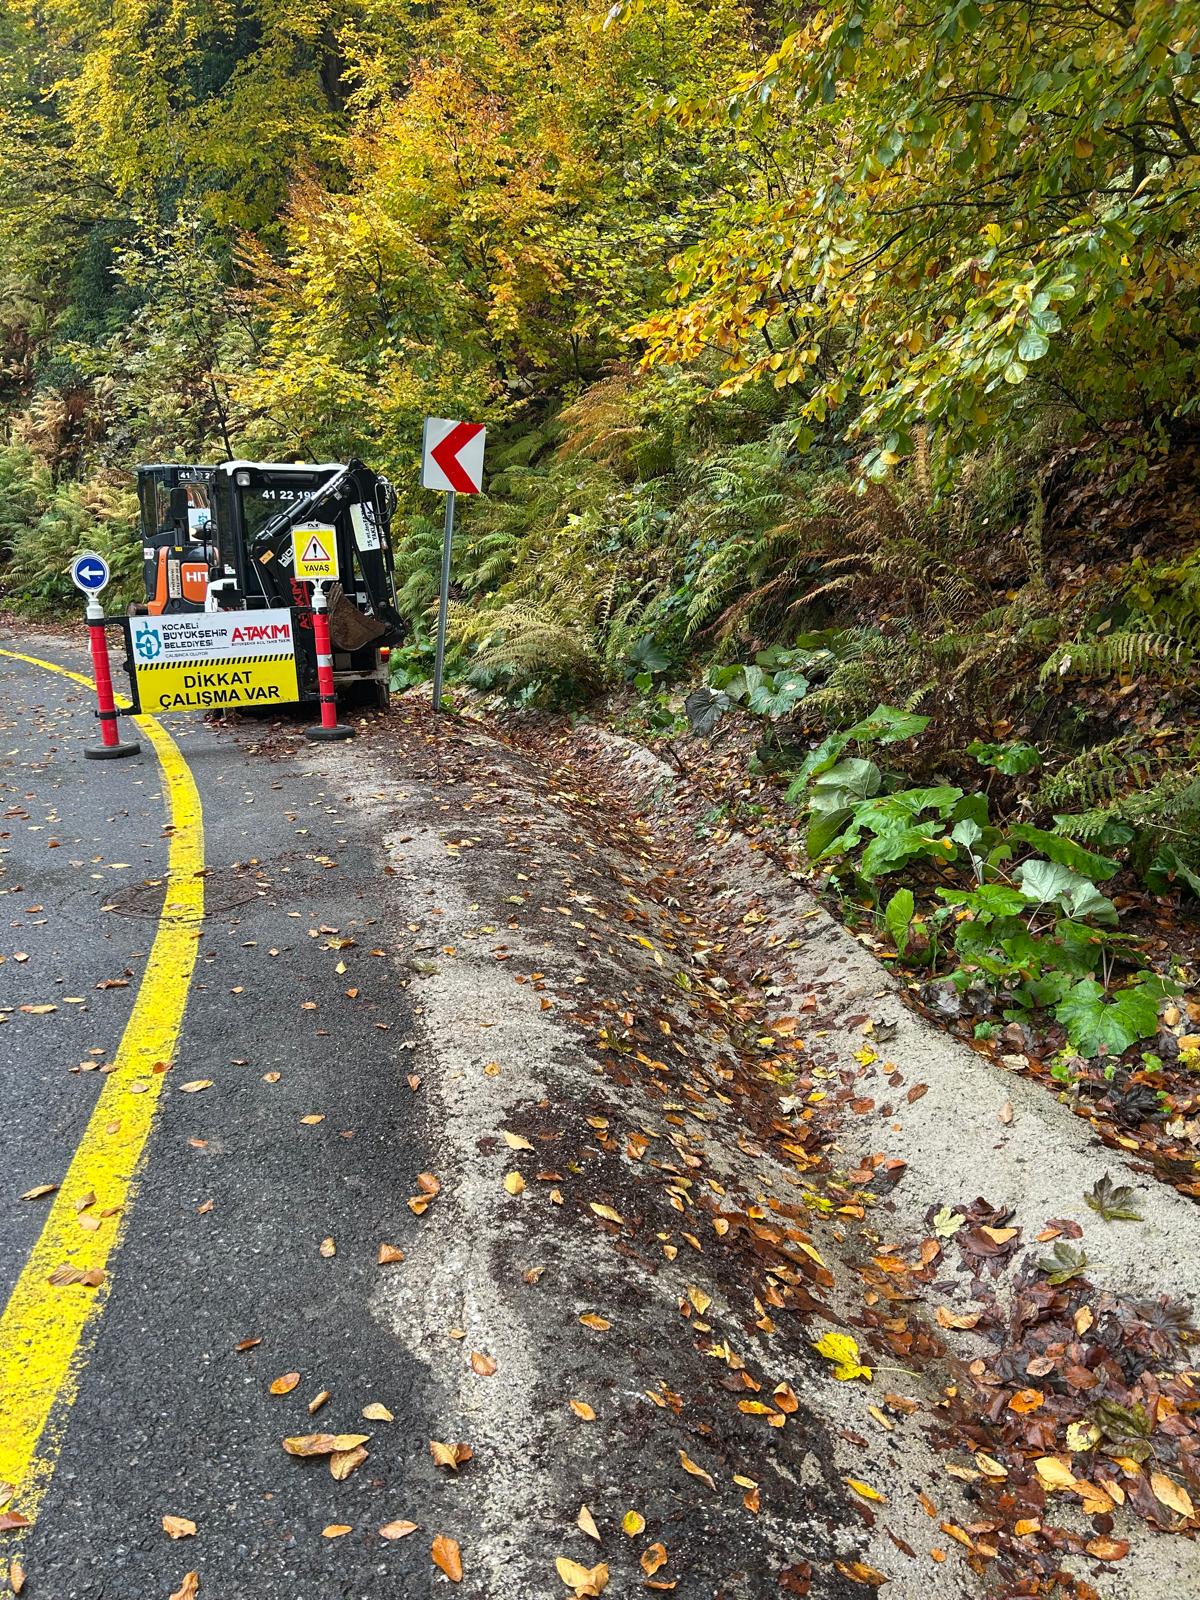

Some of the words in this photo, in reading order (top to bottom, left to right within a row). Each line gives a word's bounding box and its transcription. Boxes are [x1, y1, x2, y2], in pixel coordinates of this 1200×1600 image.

[262, 490, 276, 500] 41
[280, 490, 294, 500] 22
[366, 540, 373, 548] 25
[304, 564, 330, 573] YAVAŞ
[162, 622, 199, 632] KOCAELİ
[163, 628, 228, 641] BÜYÜKŞEHİR
[231, 624, 290, 642] A-TAKIMI
[164, 639, 214, 650] BELEDİYESİ
[184, 670, 252, 689] DİKKAT
[159, 690, 241, 710] ÇALIŞMA
[244, 686, 280, 700] VAR
